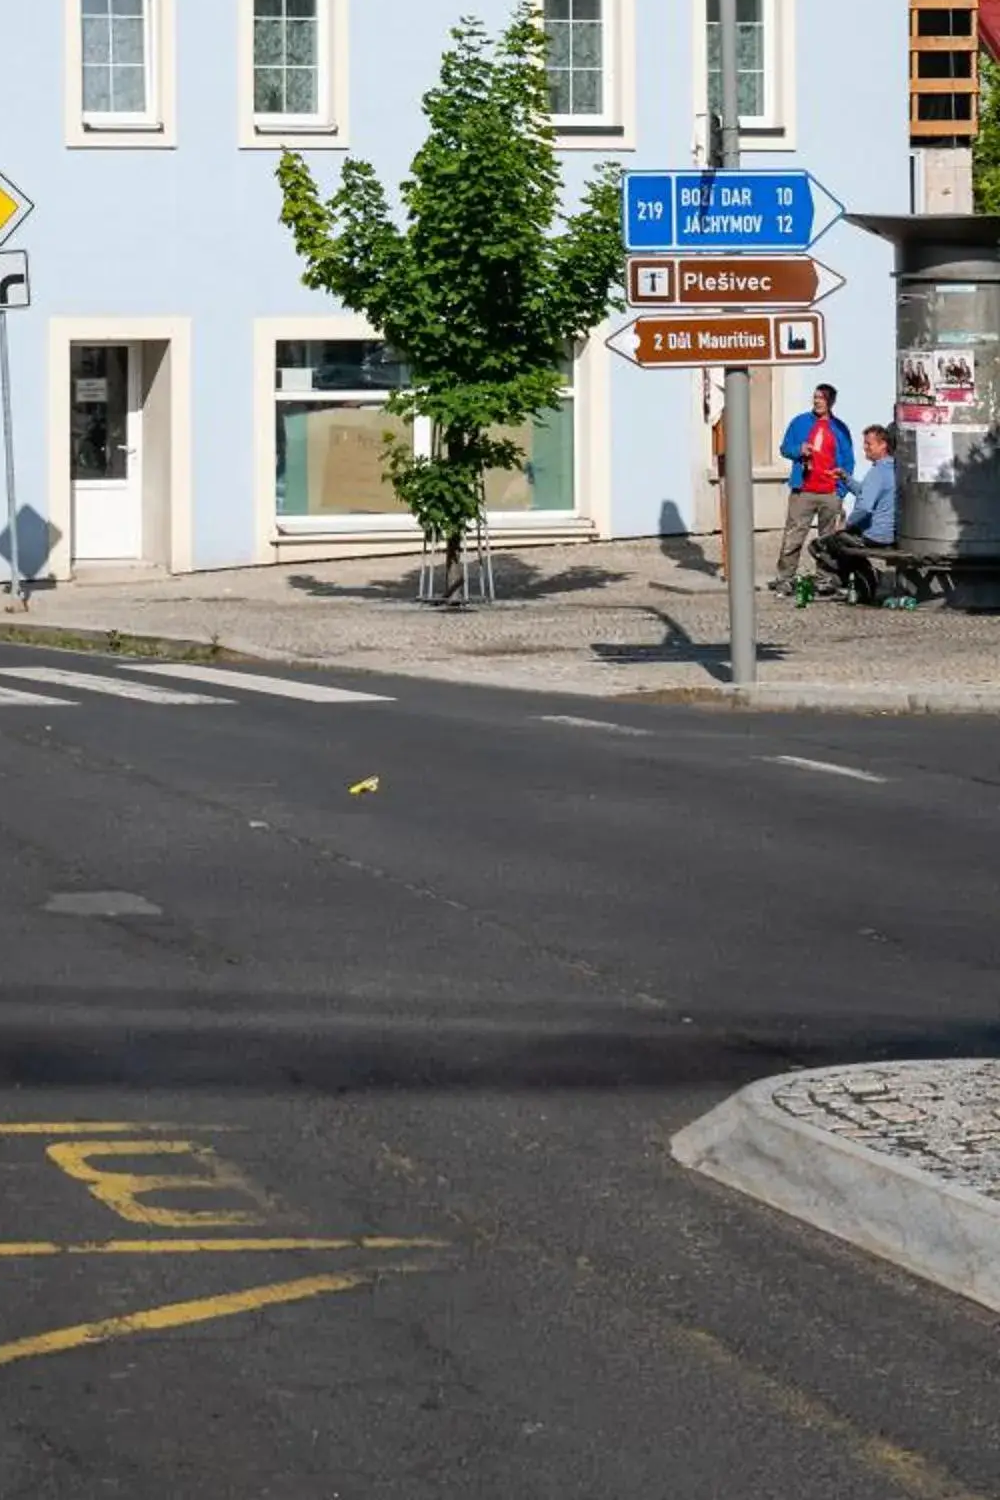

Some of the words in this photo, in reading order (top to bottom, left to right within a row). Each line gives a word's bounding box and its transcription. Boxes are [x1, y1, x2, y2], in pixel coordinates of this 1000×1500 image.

[681, 185, 716, 206] BOŽÍ
[721, 187, 752, 205] DAR
[776, 187, 794, 206] 10
[637, 201, 664, 221] 219
[683, 211, 763, 234] JÁCHYMOV
[776, 215, 793, 233] 12
[683, 271, 773, 291] Plešivec
[698, 329, 767, 349] Mauritius
